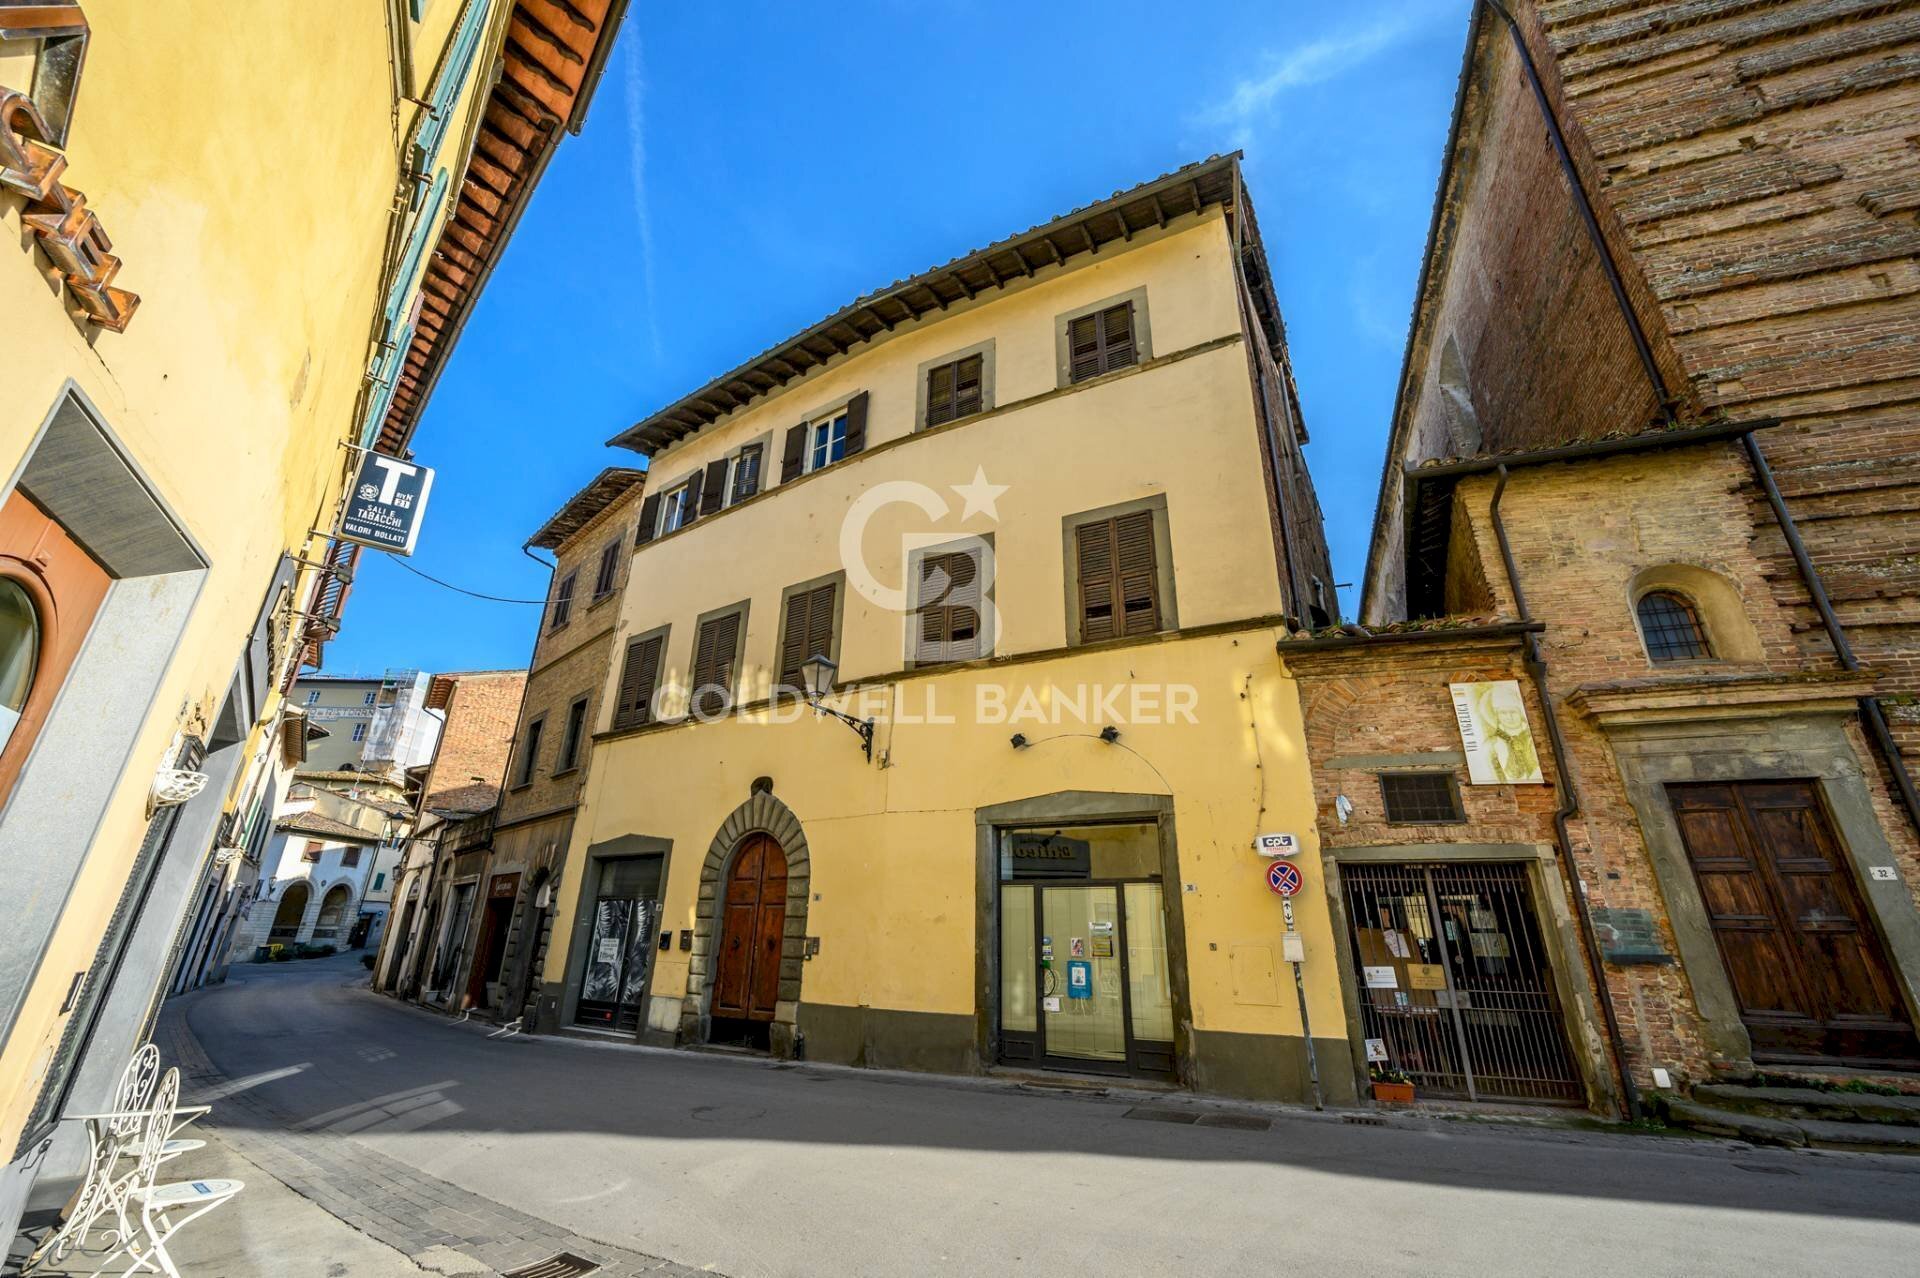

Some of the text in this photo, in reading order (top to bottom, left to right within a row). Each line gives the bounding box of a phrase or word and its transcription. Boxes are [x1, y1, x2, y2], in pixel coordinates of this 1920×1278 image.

[375, 457, 417, 506] T
[358, 508, 402, 528] TABACCHI
[367, 504, 396, 518] SALI E
[345, 522, 405, 543] VALORI BOLLATI
[1877, 869, 1888, 878] 32
